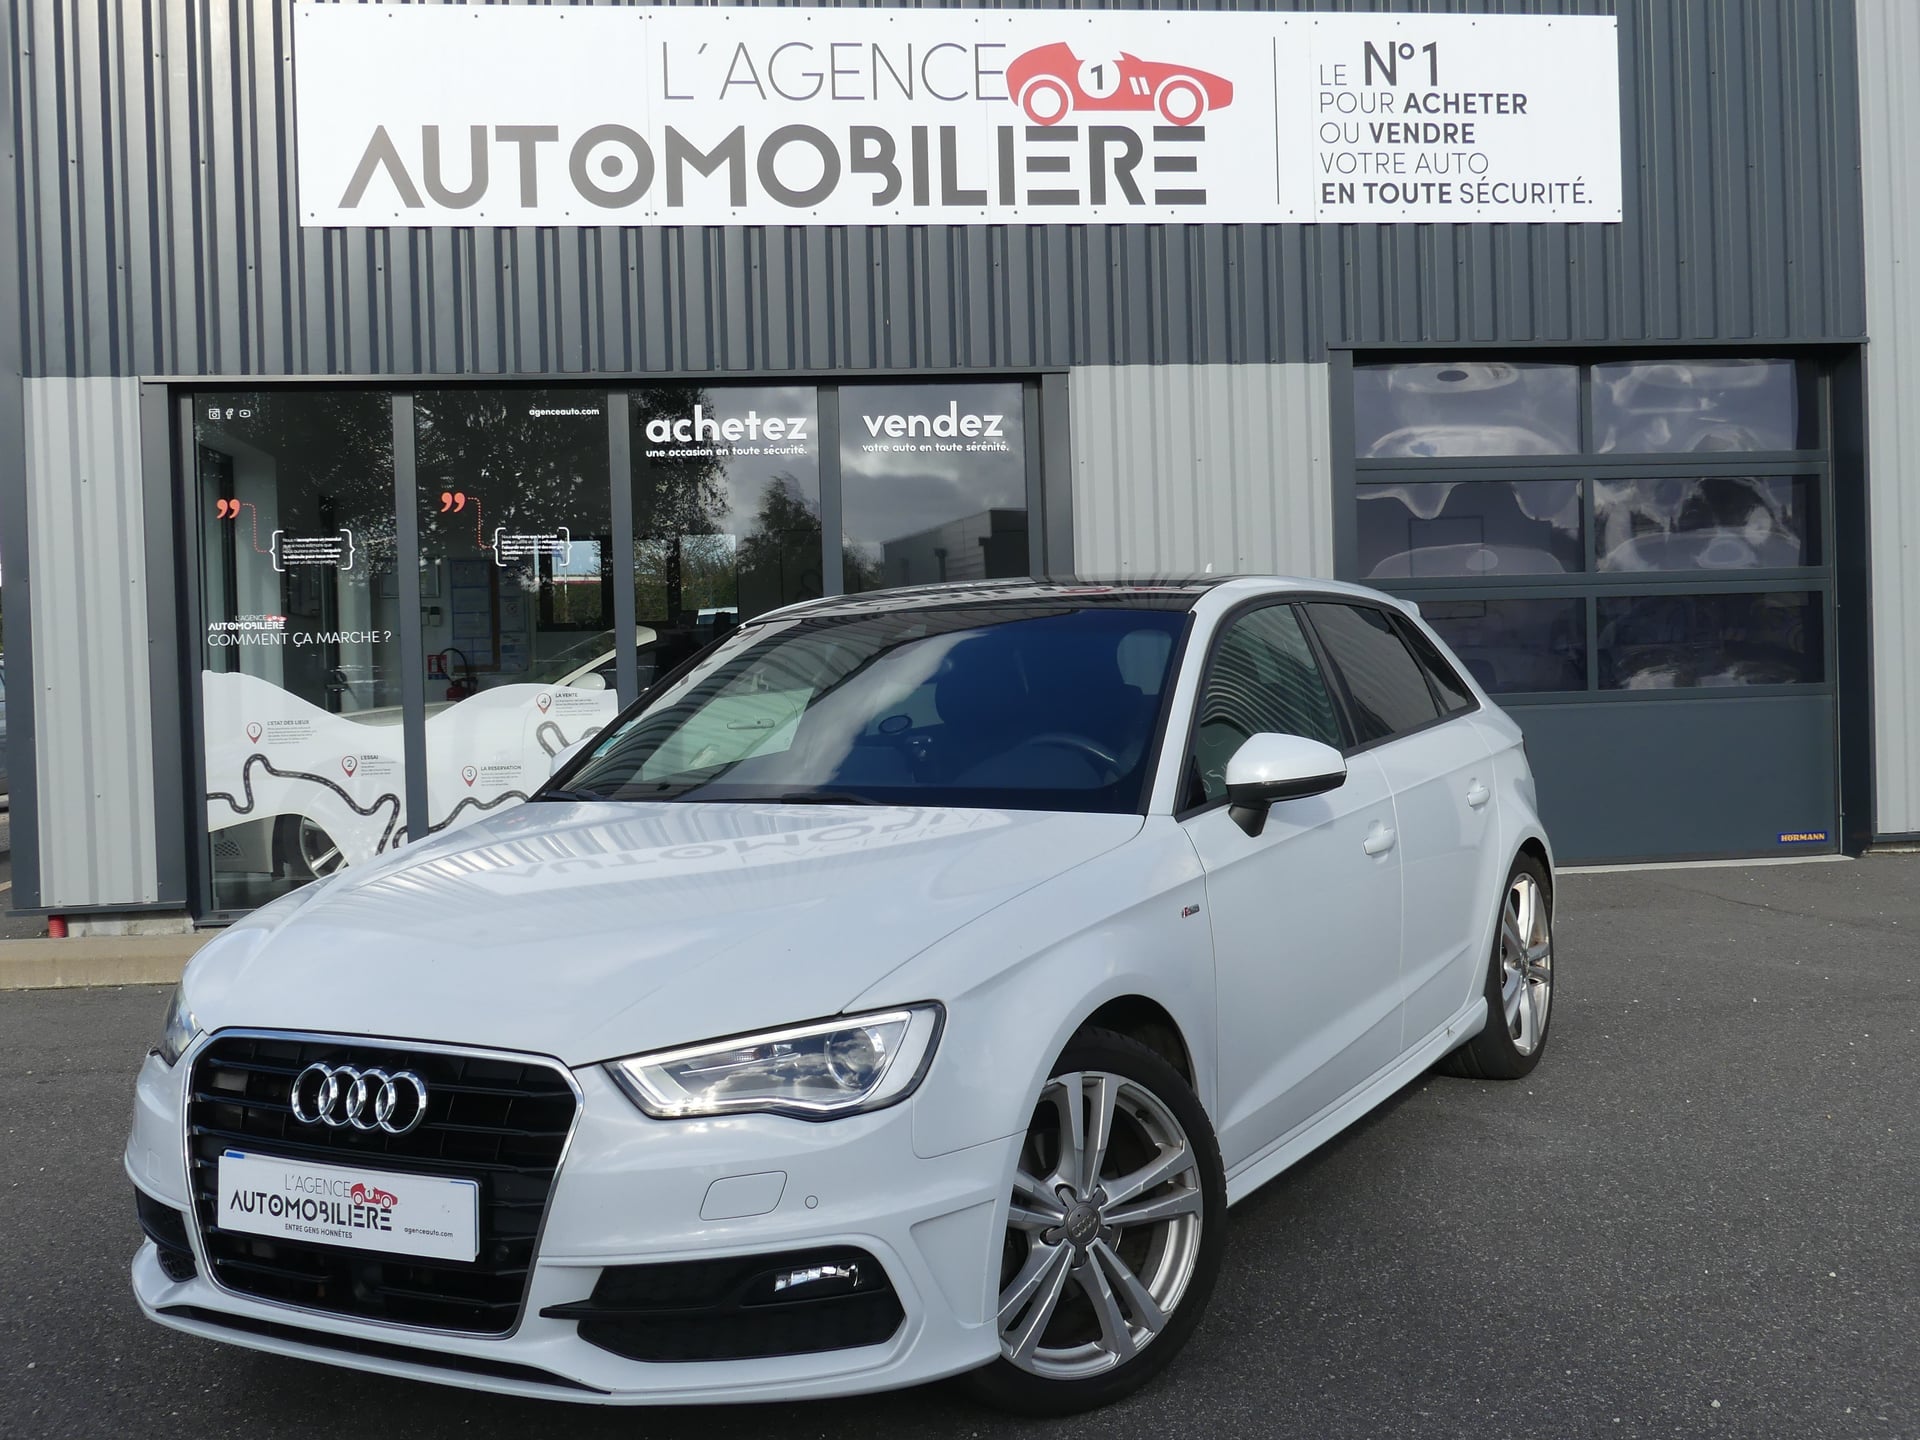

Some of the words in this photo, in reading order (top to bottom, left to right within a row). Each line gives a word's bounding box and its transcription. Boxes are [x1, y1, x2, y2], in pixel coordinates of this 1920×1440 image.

[662, 41, 1008, 101] L'AGENCE
[1090, 63, 1104, 90] 1
[1320, 64, 1347, 86] LE
[1319, 92, 1395, 114] POUR
[1403, 92, 1528, 114] ACHETER
[1319, 122, 1360, 144] OU
[1369, 122, 1475, 144] VENDRE
[337, 123, 1206, 209] AUTOMOBILIERE
[1320, 152, 1406, 174] VOTRE
[1415, 152, 1489, 174] AUTO
[1322, 183, 1355, 204] EN
[1363, 182, 1453, 204] TOUTE
[1460, 175, 1593, 204] SÉCURITÉ.
[528, 407, 600, 418] agenceauto.com
[645, 404, 808, 443] achetez
[862, 400, 1004, 438] vendez
[646, 449, 666, 458] une
[668, 446, 714, 458] occasion
[716, 448, 729, 456] en
[732, 446, 761, 456] toute
[763, 444, 808, 455] sécurité.
[862, 443, 889, 452] votre
[892, 443, 917, 452] auto
[919, 444, 932, 452] en
[935, 442, 963, 452] toute
[966, 440, 1010, 452] sérénité.
[208, 621, 286, 631] AUTOMOBILIERE
[235, 614, 267, 622] L'AGENCE
[207, 632, 289, 647] COMMENT
[292, 632, 313, 647] ÇA
[316, 630, 381, 644] MARCHE
[383, 630, 392, 643] ?
[346, 759, 353, 768] 2
[466, 769, 473, 778] 3
[284, 1173, 351, 1199] L'AGENCE
[230, 1189, 392, 1232] AUTOMOBILIERE
[285, 1223, 303, 1233] ENTRE
[304, 1226, 320, 1235] GENS
[320, 1228, 353, 1239] HONNÊTES
[404, 1226, 454, 1238] agenceauto.com
